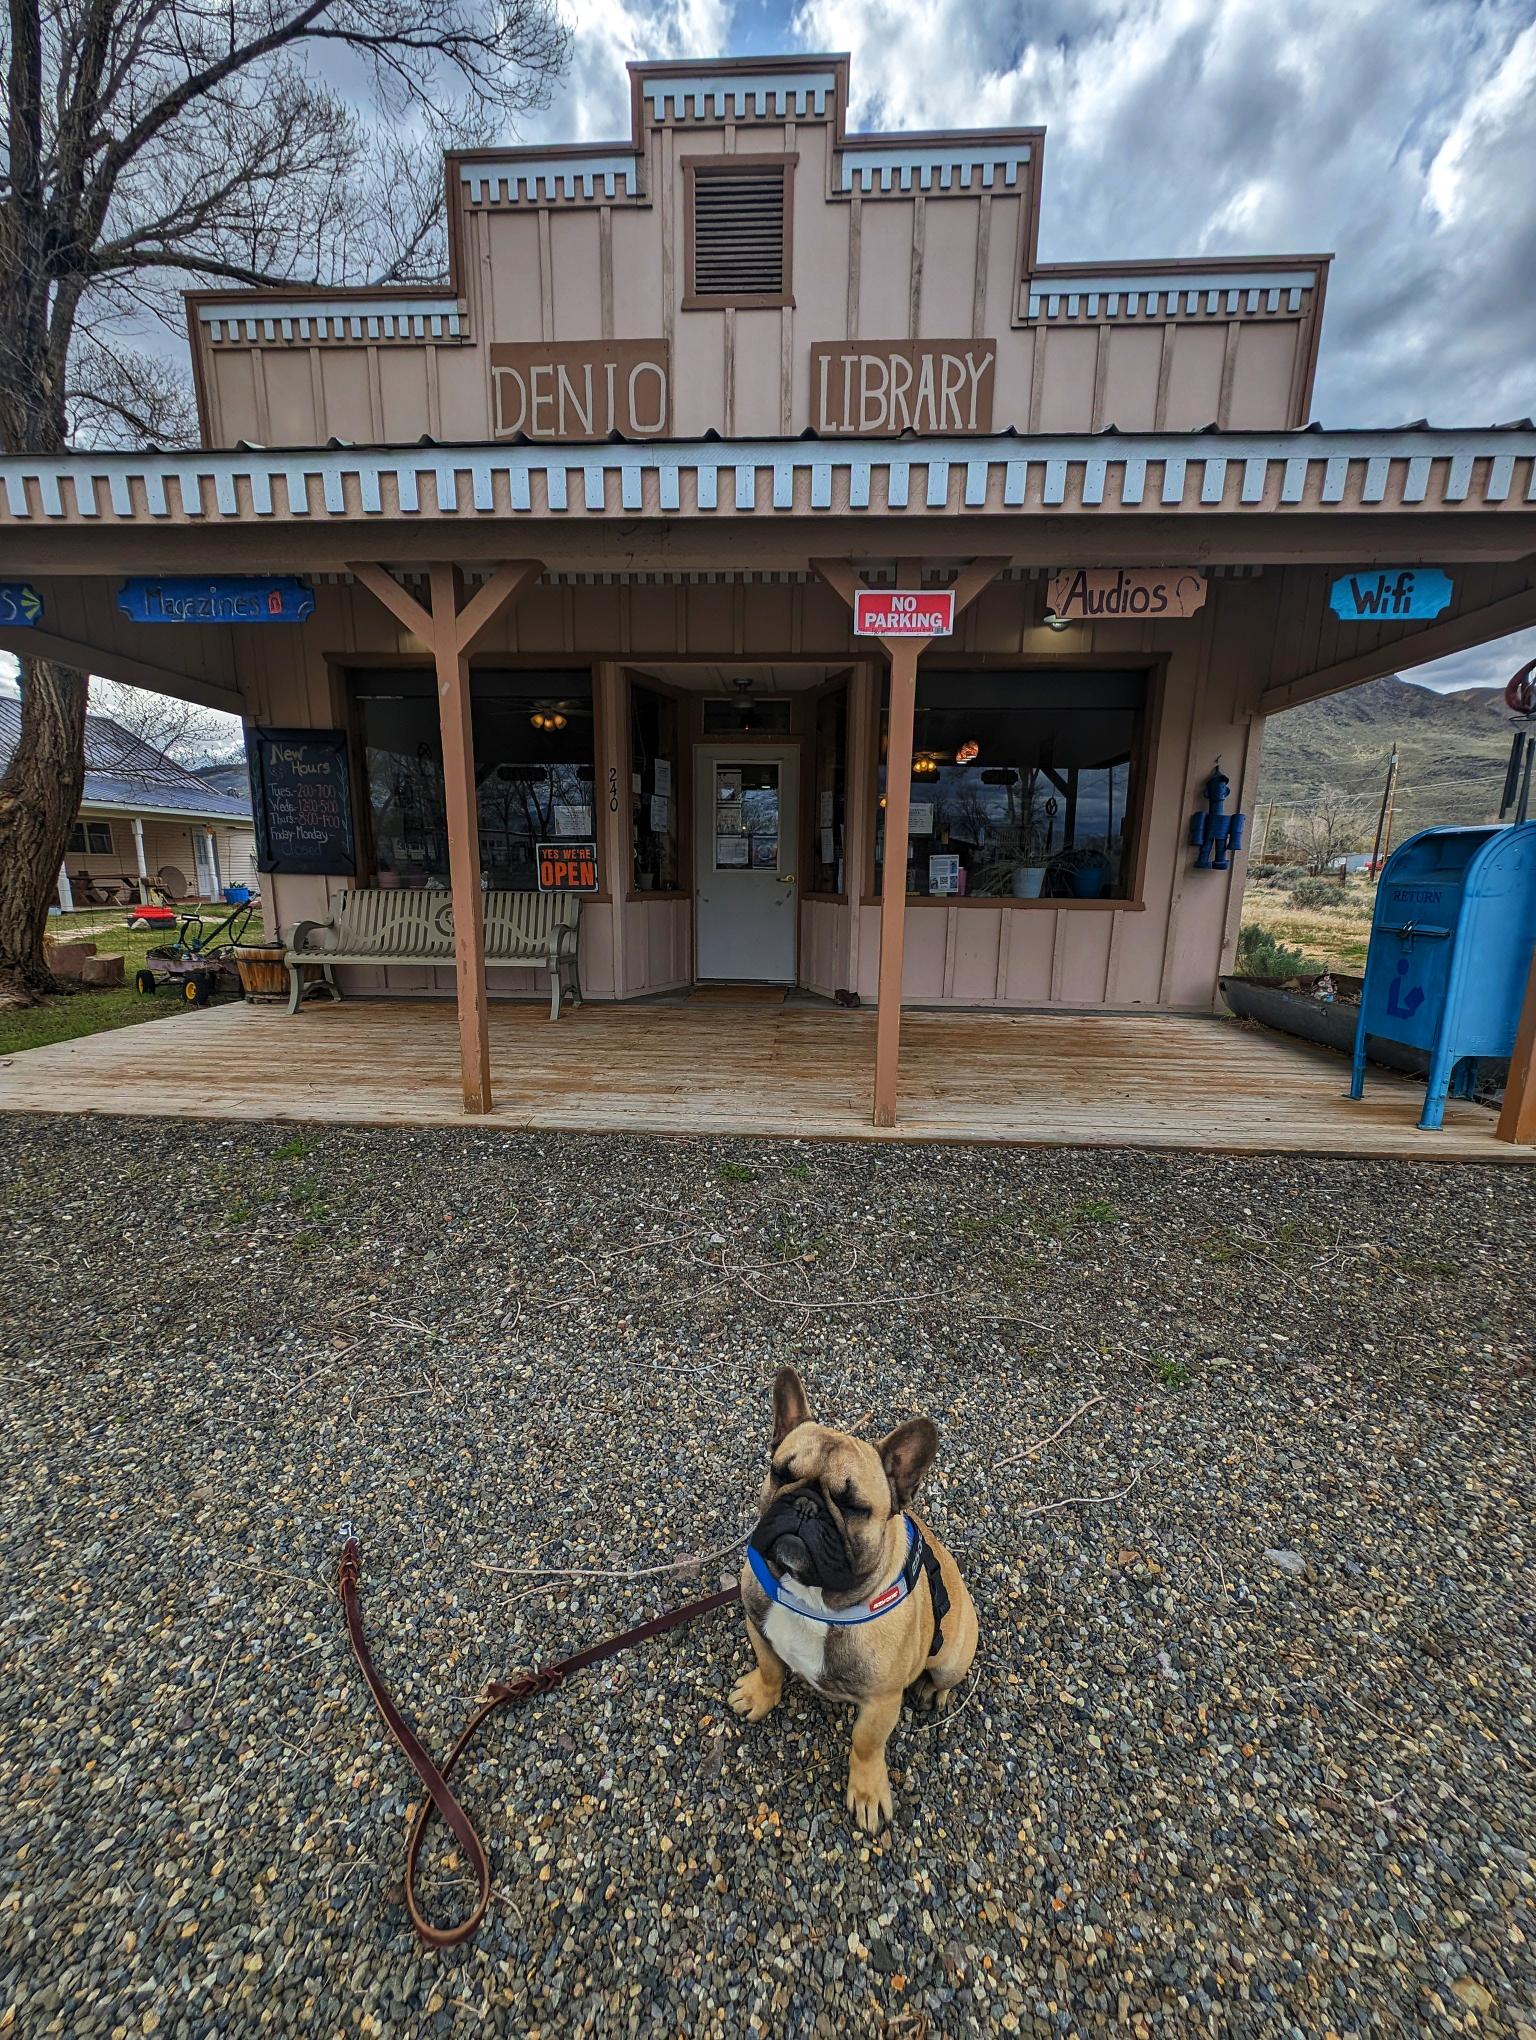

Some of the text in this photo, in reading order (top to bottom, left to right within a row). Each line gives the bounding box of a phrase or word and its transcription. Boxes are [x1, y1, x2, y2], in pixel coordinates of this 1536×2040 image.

[491, 351, 995, 438] DENIO LIBRARY
[144, 586, 261, 622] Magazines
[891, 596, 917, 612] NO
[1061, 570, 1169, 616] Audios
[1350, 572, 1415, 615] Wifi
[864, 612, 943, 628] PARKING
[269, 744, 308, 765] New
[291, 761, 331, 776] Hours
[609, 767, 618, 812] 240
[542, 849, 591, 859] YES WE'RE
[541, 861, 595, 886] OPEN
[1392, 889, 1443, 904] RETURN
